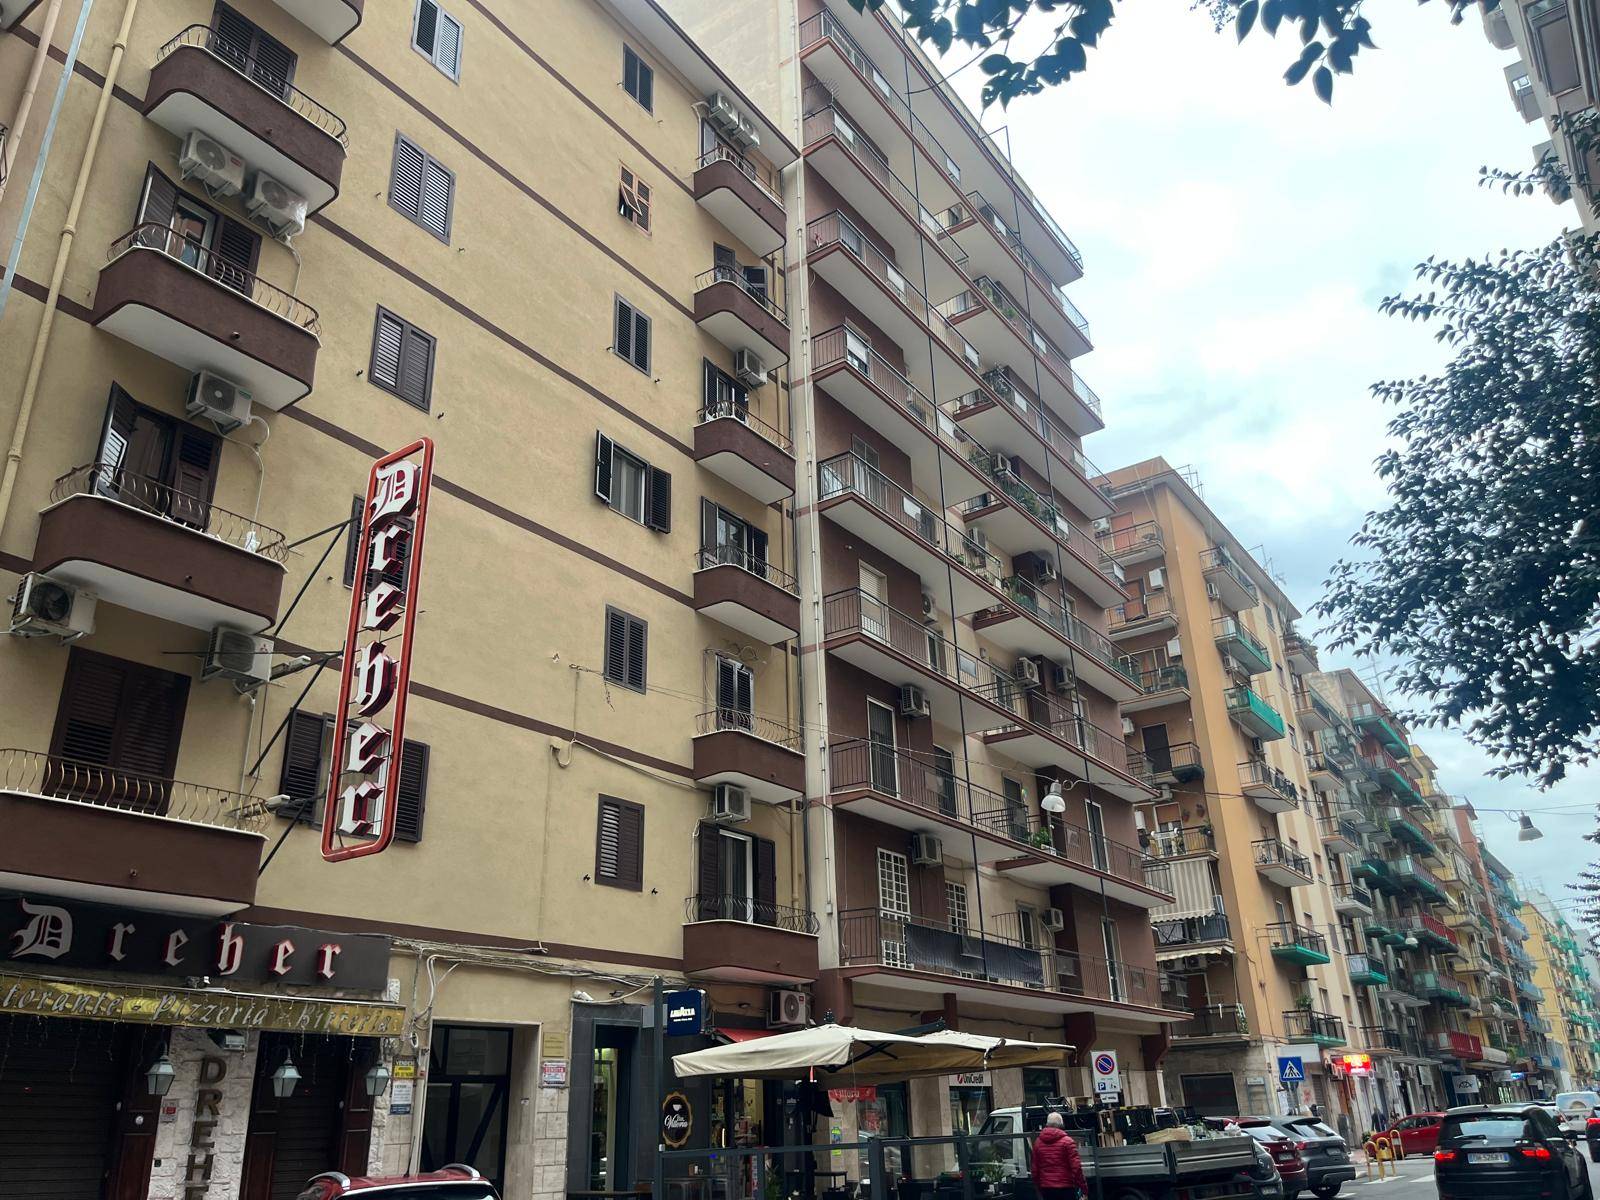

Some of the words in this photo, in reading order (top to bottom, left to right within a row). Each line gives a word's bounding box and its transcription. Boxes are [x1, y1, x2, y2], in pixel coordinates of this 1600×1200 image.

[339, 458, 419, 837] Dreher
[10, 897, 342, 979] Dreher
[0, 983, 125, 1016] torante
[153, 993, 269, 1026] Pizzeria
[297, 1001, 393, 1033] Birreria
